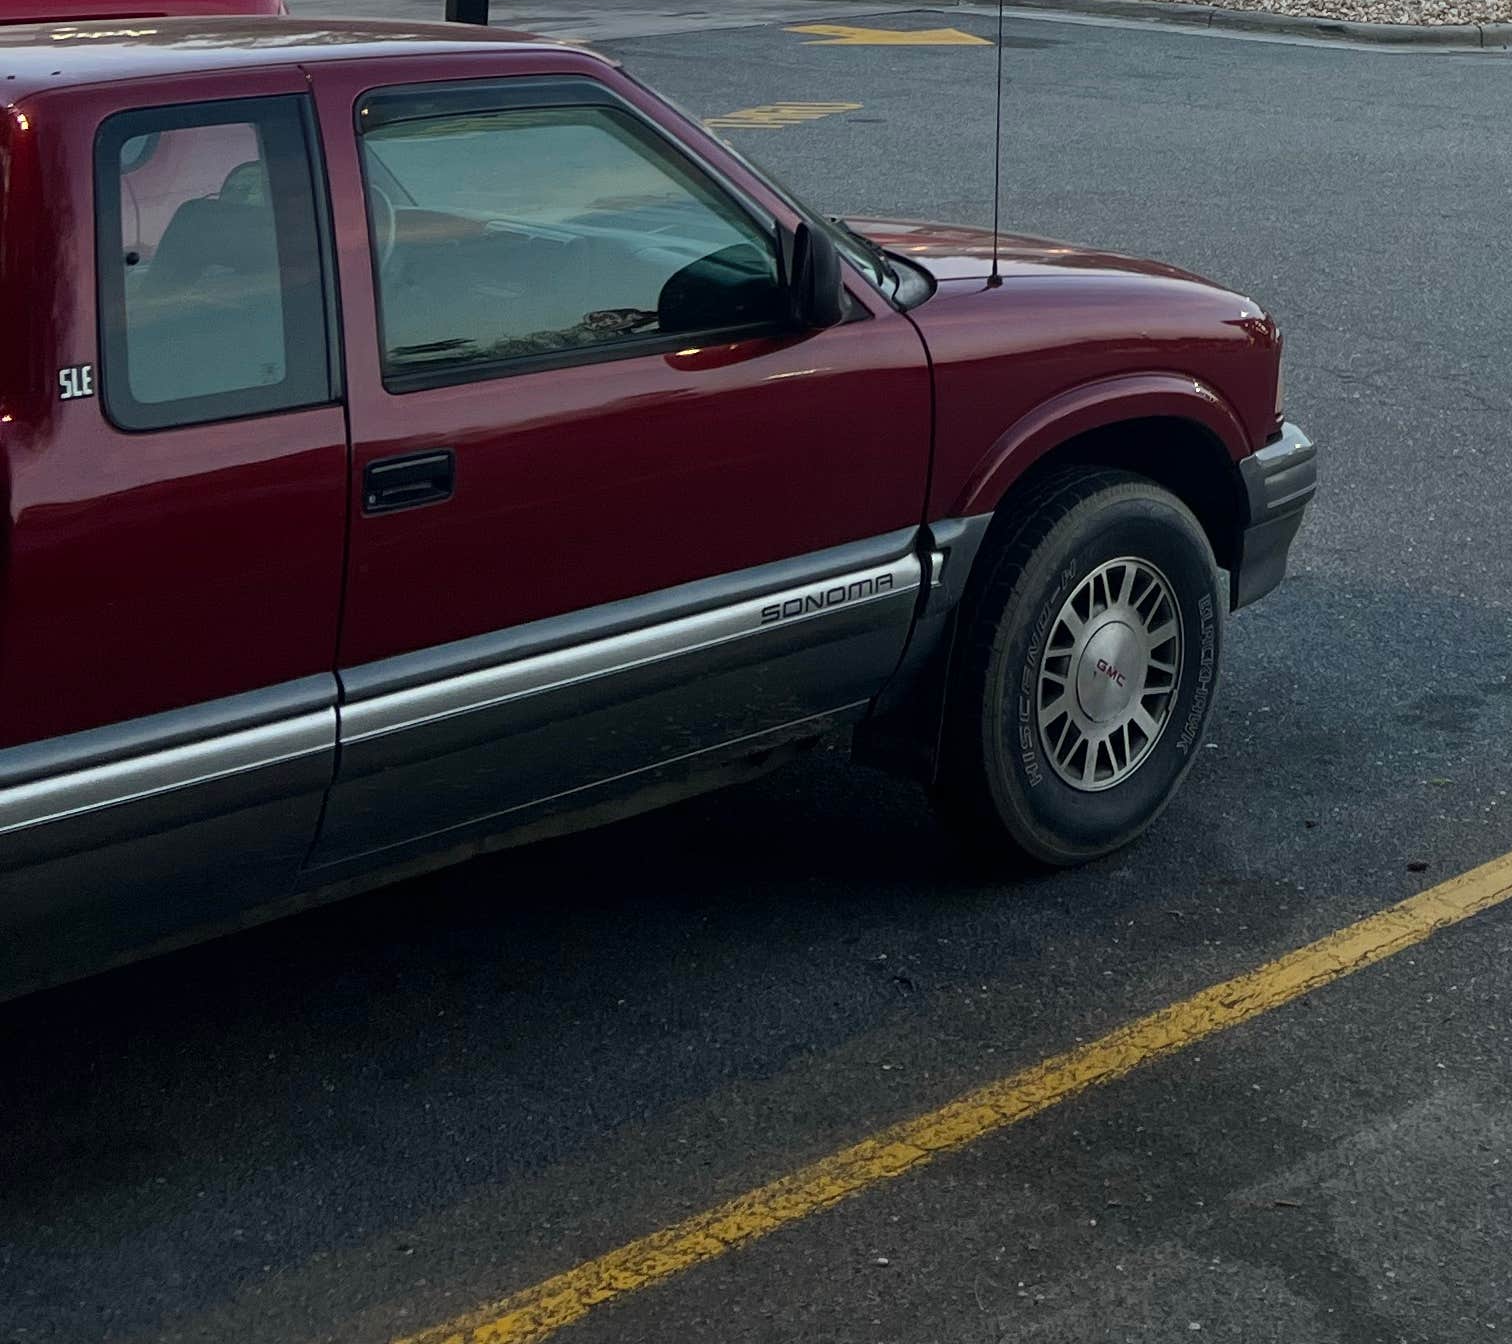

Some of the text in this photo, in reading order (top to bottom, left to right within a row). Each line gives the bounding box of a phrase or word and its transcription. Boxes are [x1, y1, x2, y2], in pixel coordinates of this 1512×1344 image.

[59, 365, 93, 399] SLE
[761, 572, 894, 625] SONOMA
[1096, 658, 1127, 688] GMC
